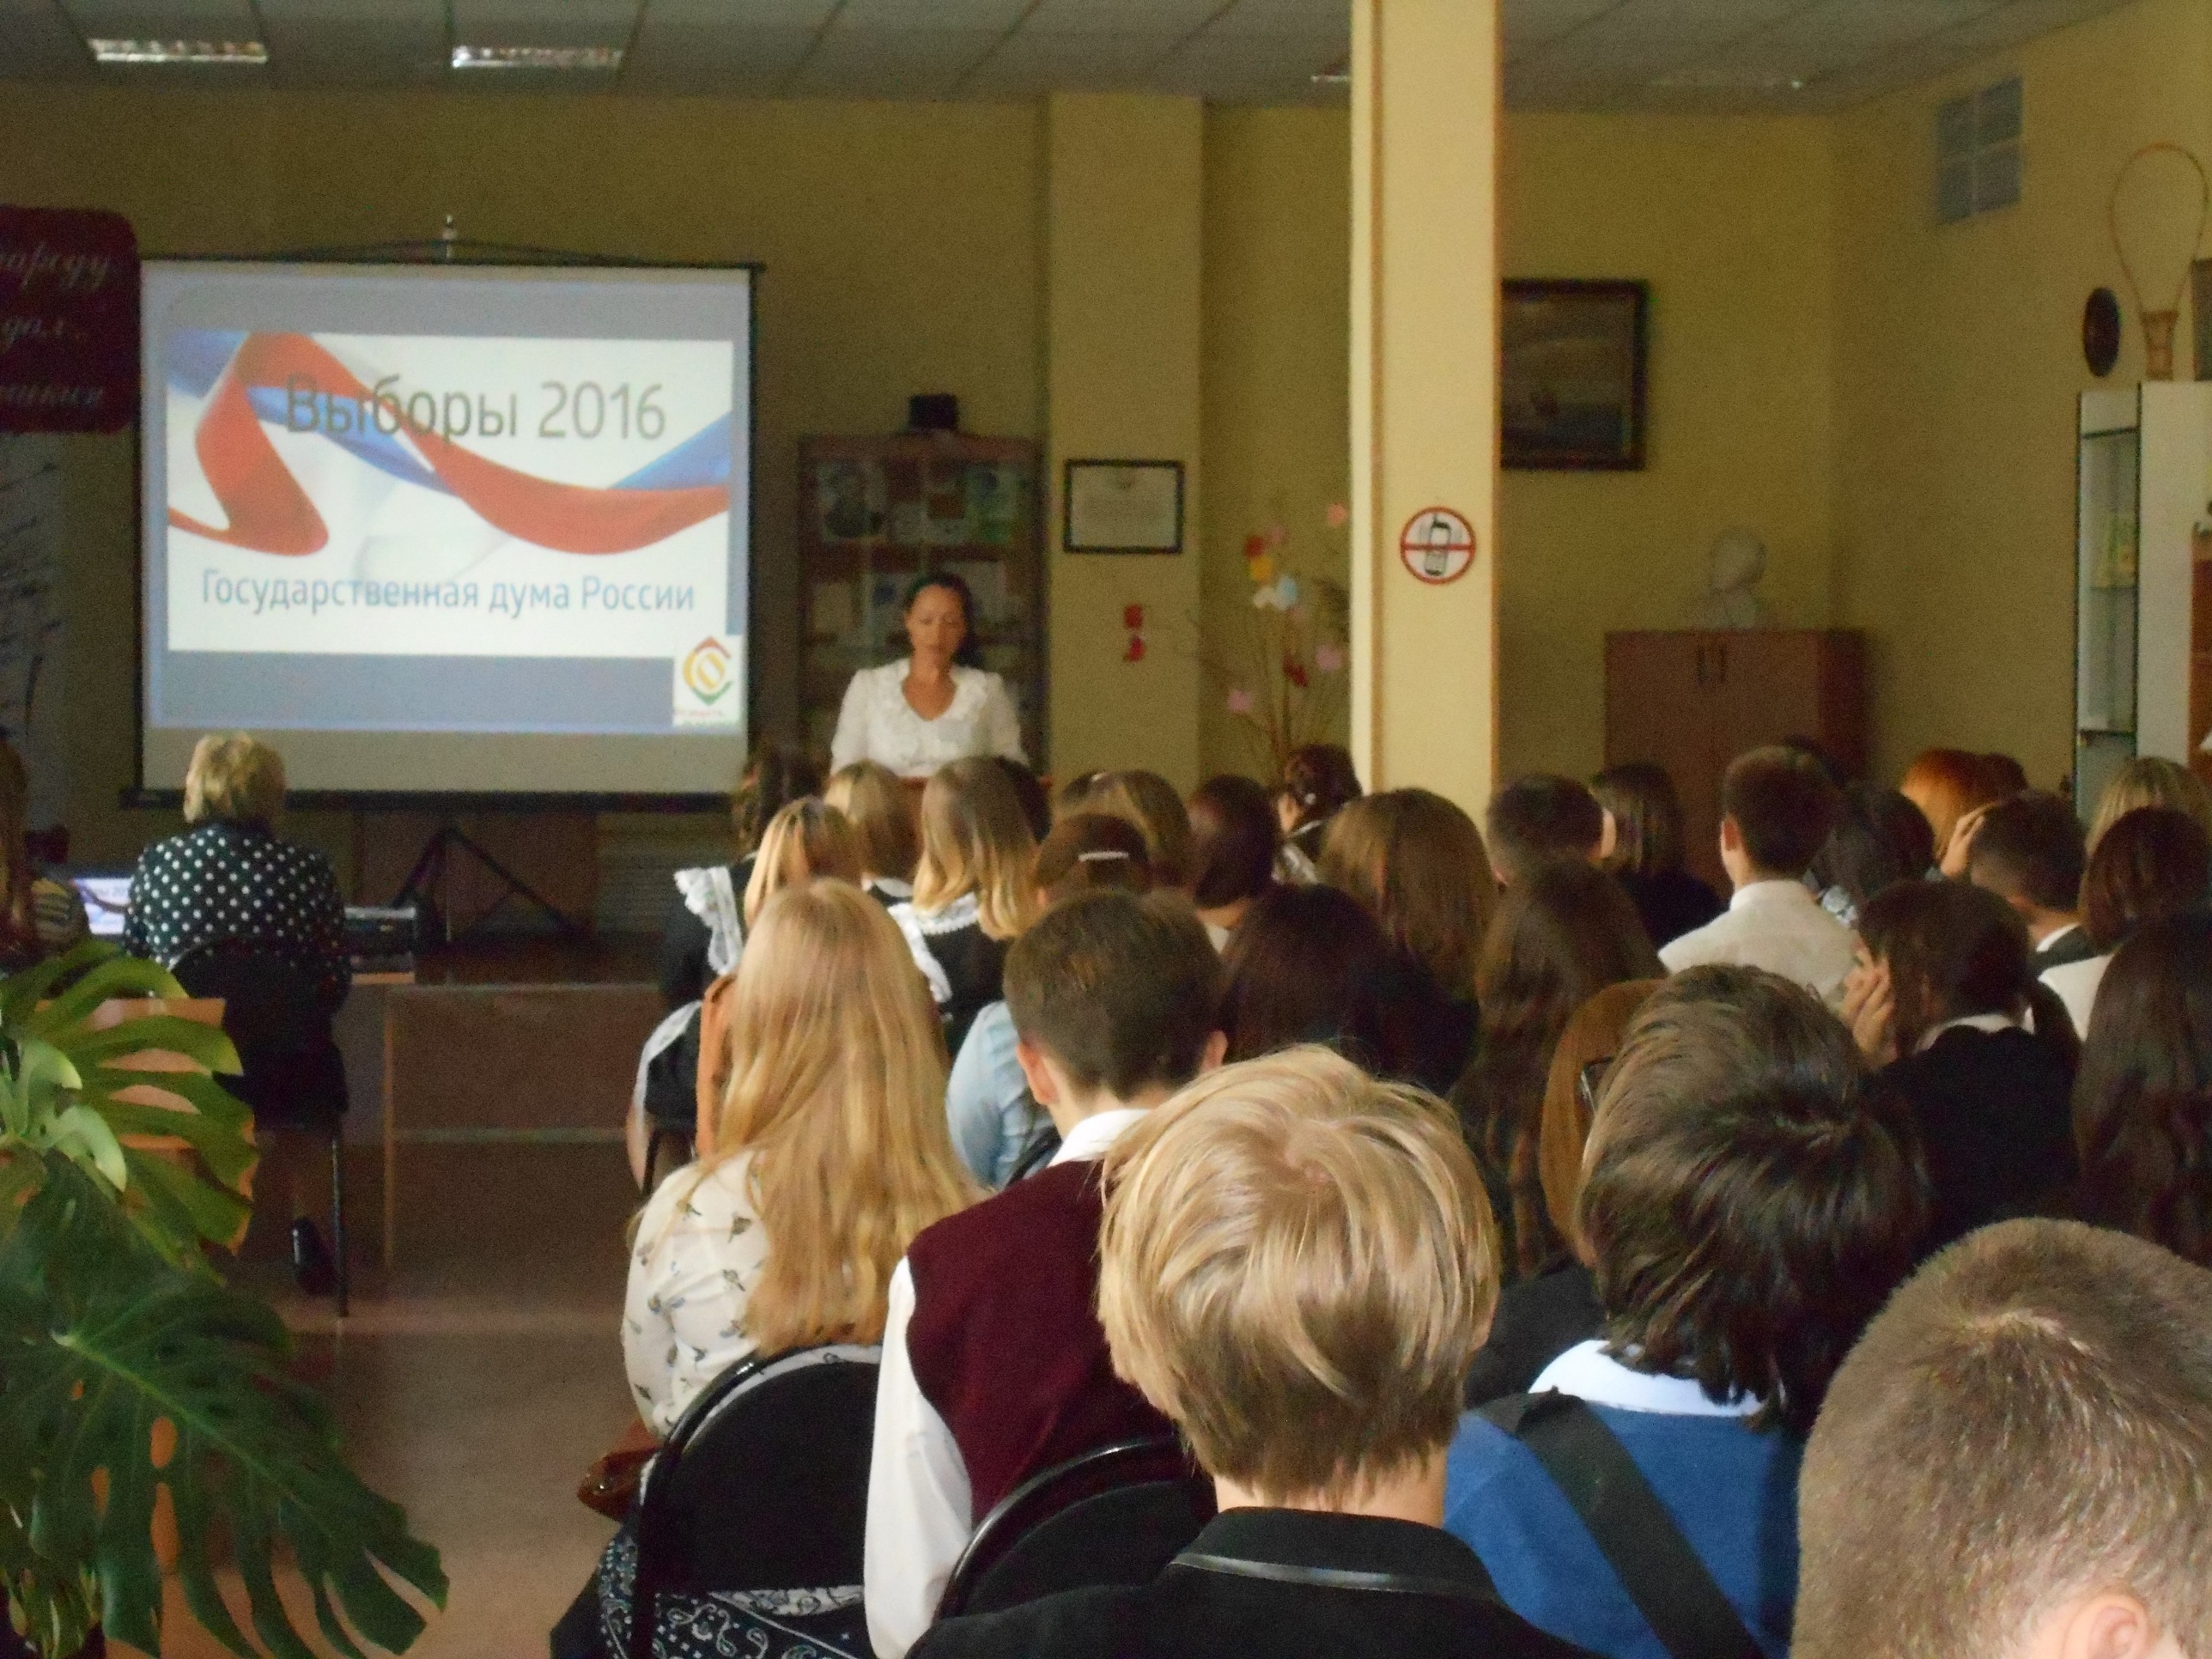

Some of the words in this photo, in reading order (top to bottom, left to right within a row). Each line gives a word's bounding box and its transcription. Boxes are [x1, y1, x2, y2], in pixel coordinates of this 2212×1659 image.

[285, 373, 518, 444] Выборы
[538, 380, 667, 441] 2016
[202, 568, 479, 617] Государственная
[489, 581, 570, 619] дума
[581, 574, 696, 611] России
